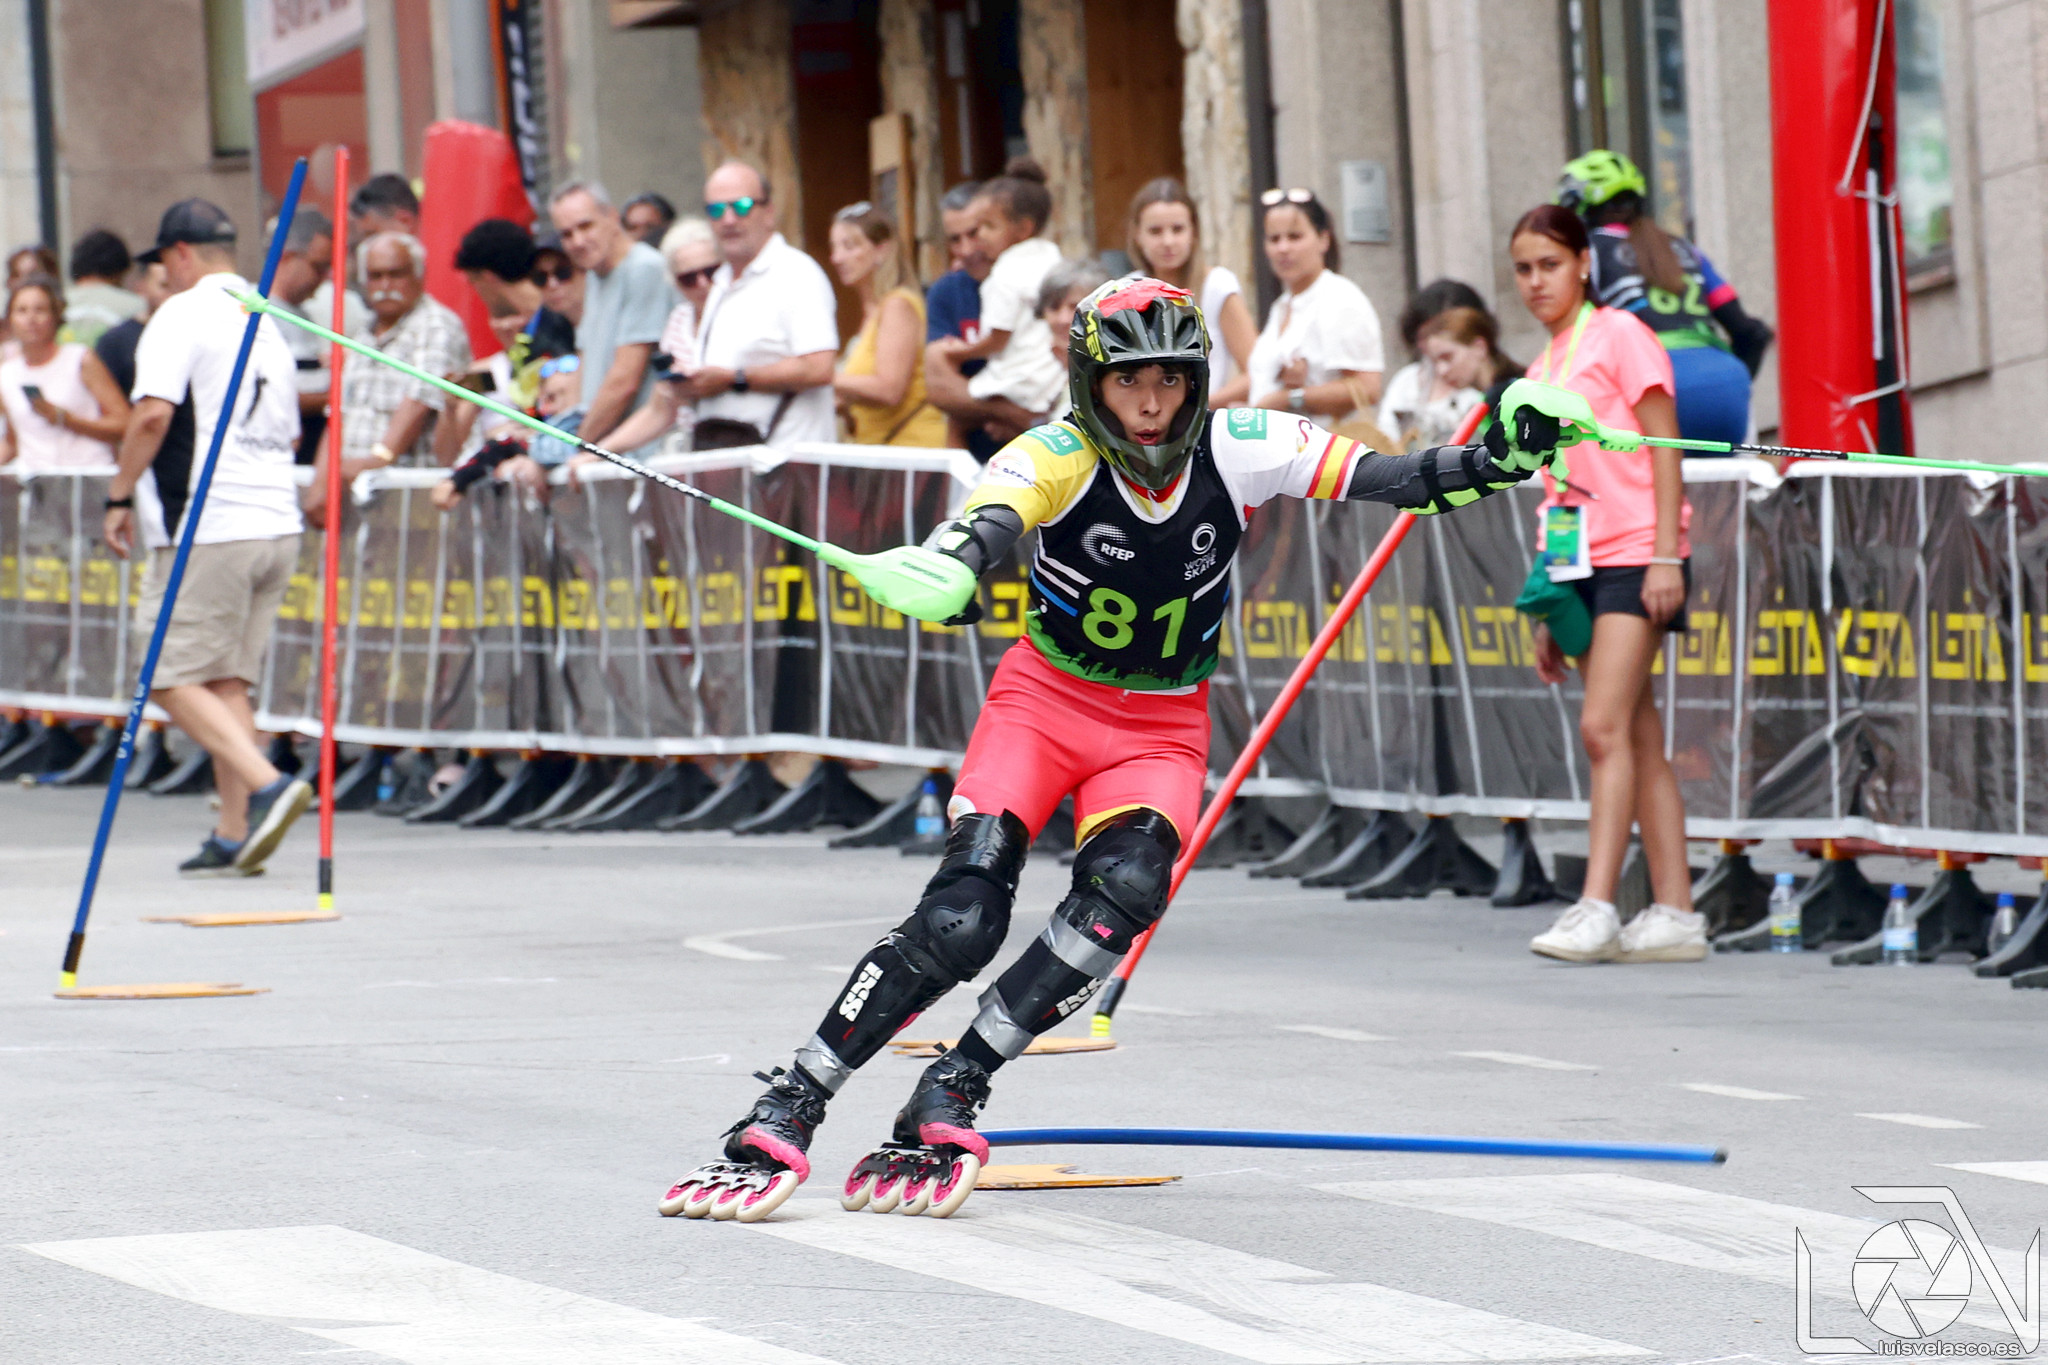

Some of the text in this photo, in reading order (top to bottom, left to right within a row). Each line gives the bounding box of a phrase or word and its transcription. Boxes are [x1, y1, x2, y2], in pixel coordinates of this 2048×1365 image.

[1100, 542, 1136, 562] RFEP
[1183, 559, 1217, 581] SKATE
[1082, 587, 1188, 659] 81
